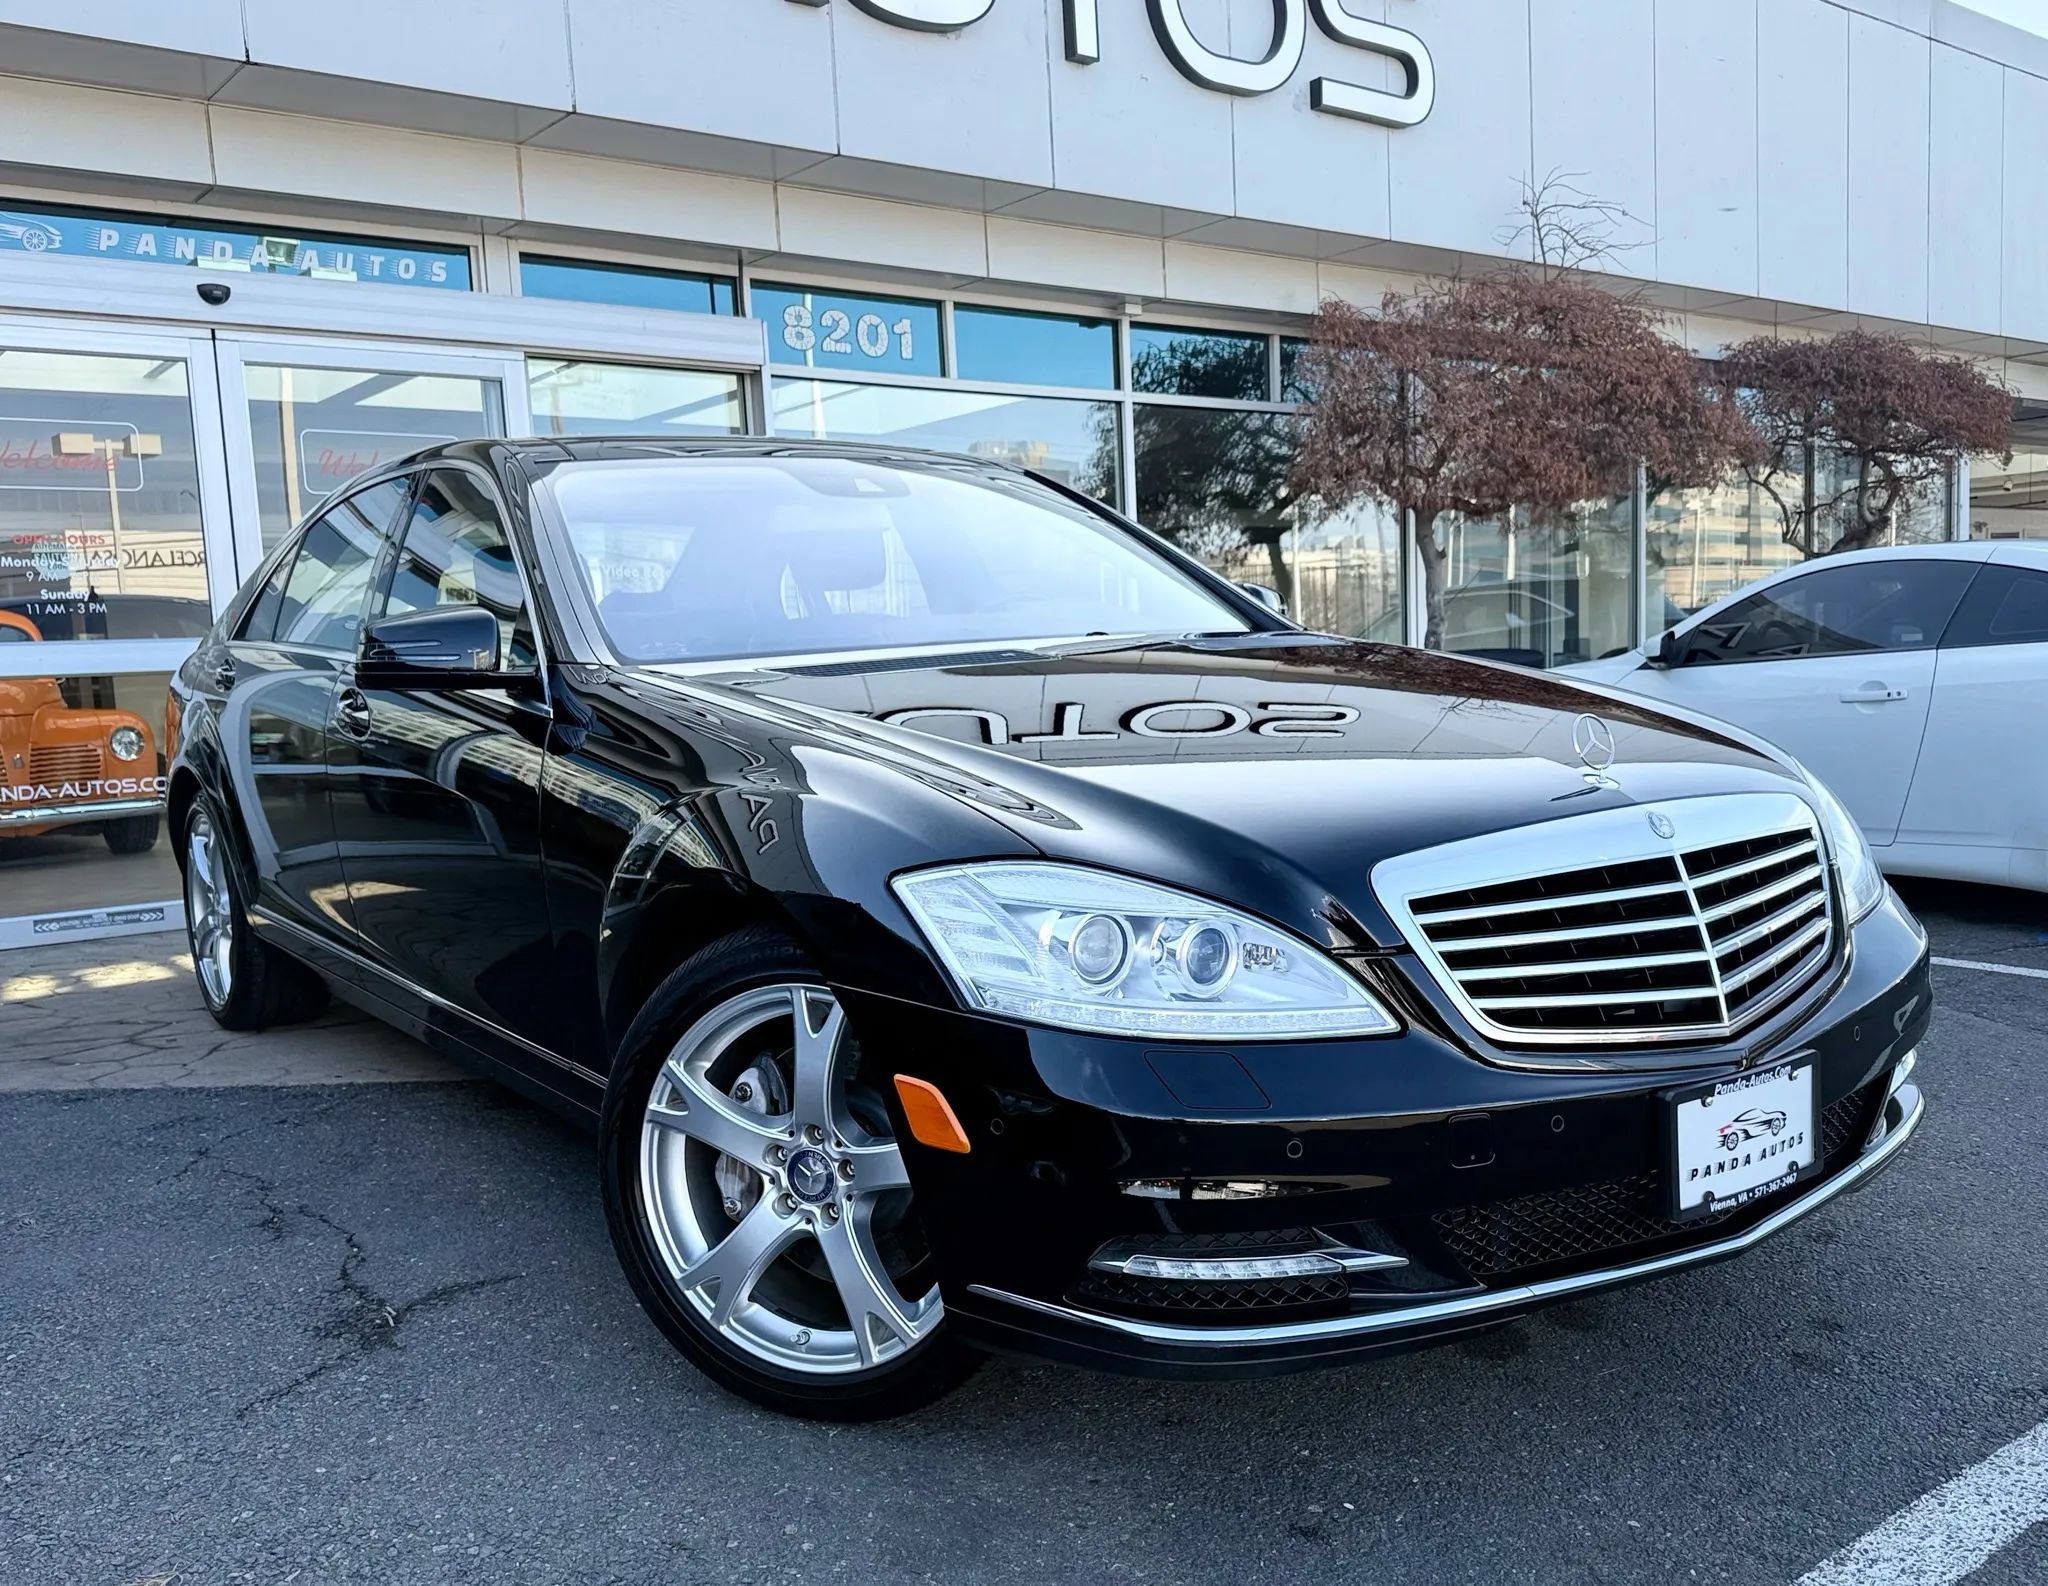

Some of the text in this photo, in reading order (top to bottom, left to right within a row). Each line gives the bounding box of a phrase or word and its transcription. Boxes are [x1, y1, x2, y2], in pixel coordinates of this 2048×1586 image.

[98, 228, 448, 283] PANDA AUTOS
[782, 304, 913, 360] 8201
[26, 571, 34, 582] 9
[41, 589, 91, 603] Sunday
[27, 604, 41, 615] 11
[45, 604, 66, 615] AM
[78, 604, 86, 614] 3
[89, 603, 108, 614] PM
[1714, 1065, 1792, 1096] Panda-Autos.Com
[1689, 1131, 1804, 1181] PANDA AUTOS
[1710, 1196, 1738, 1212] Vienna,
[1738, 1193, 1748, 1204] VA
